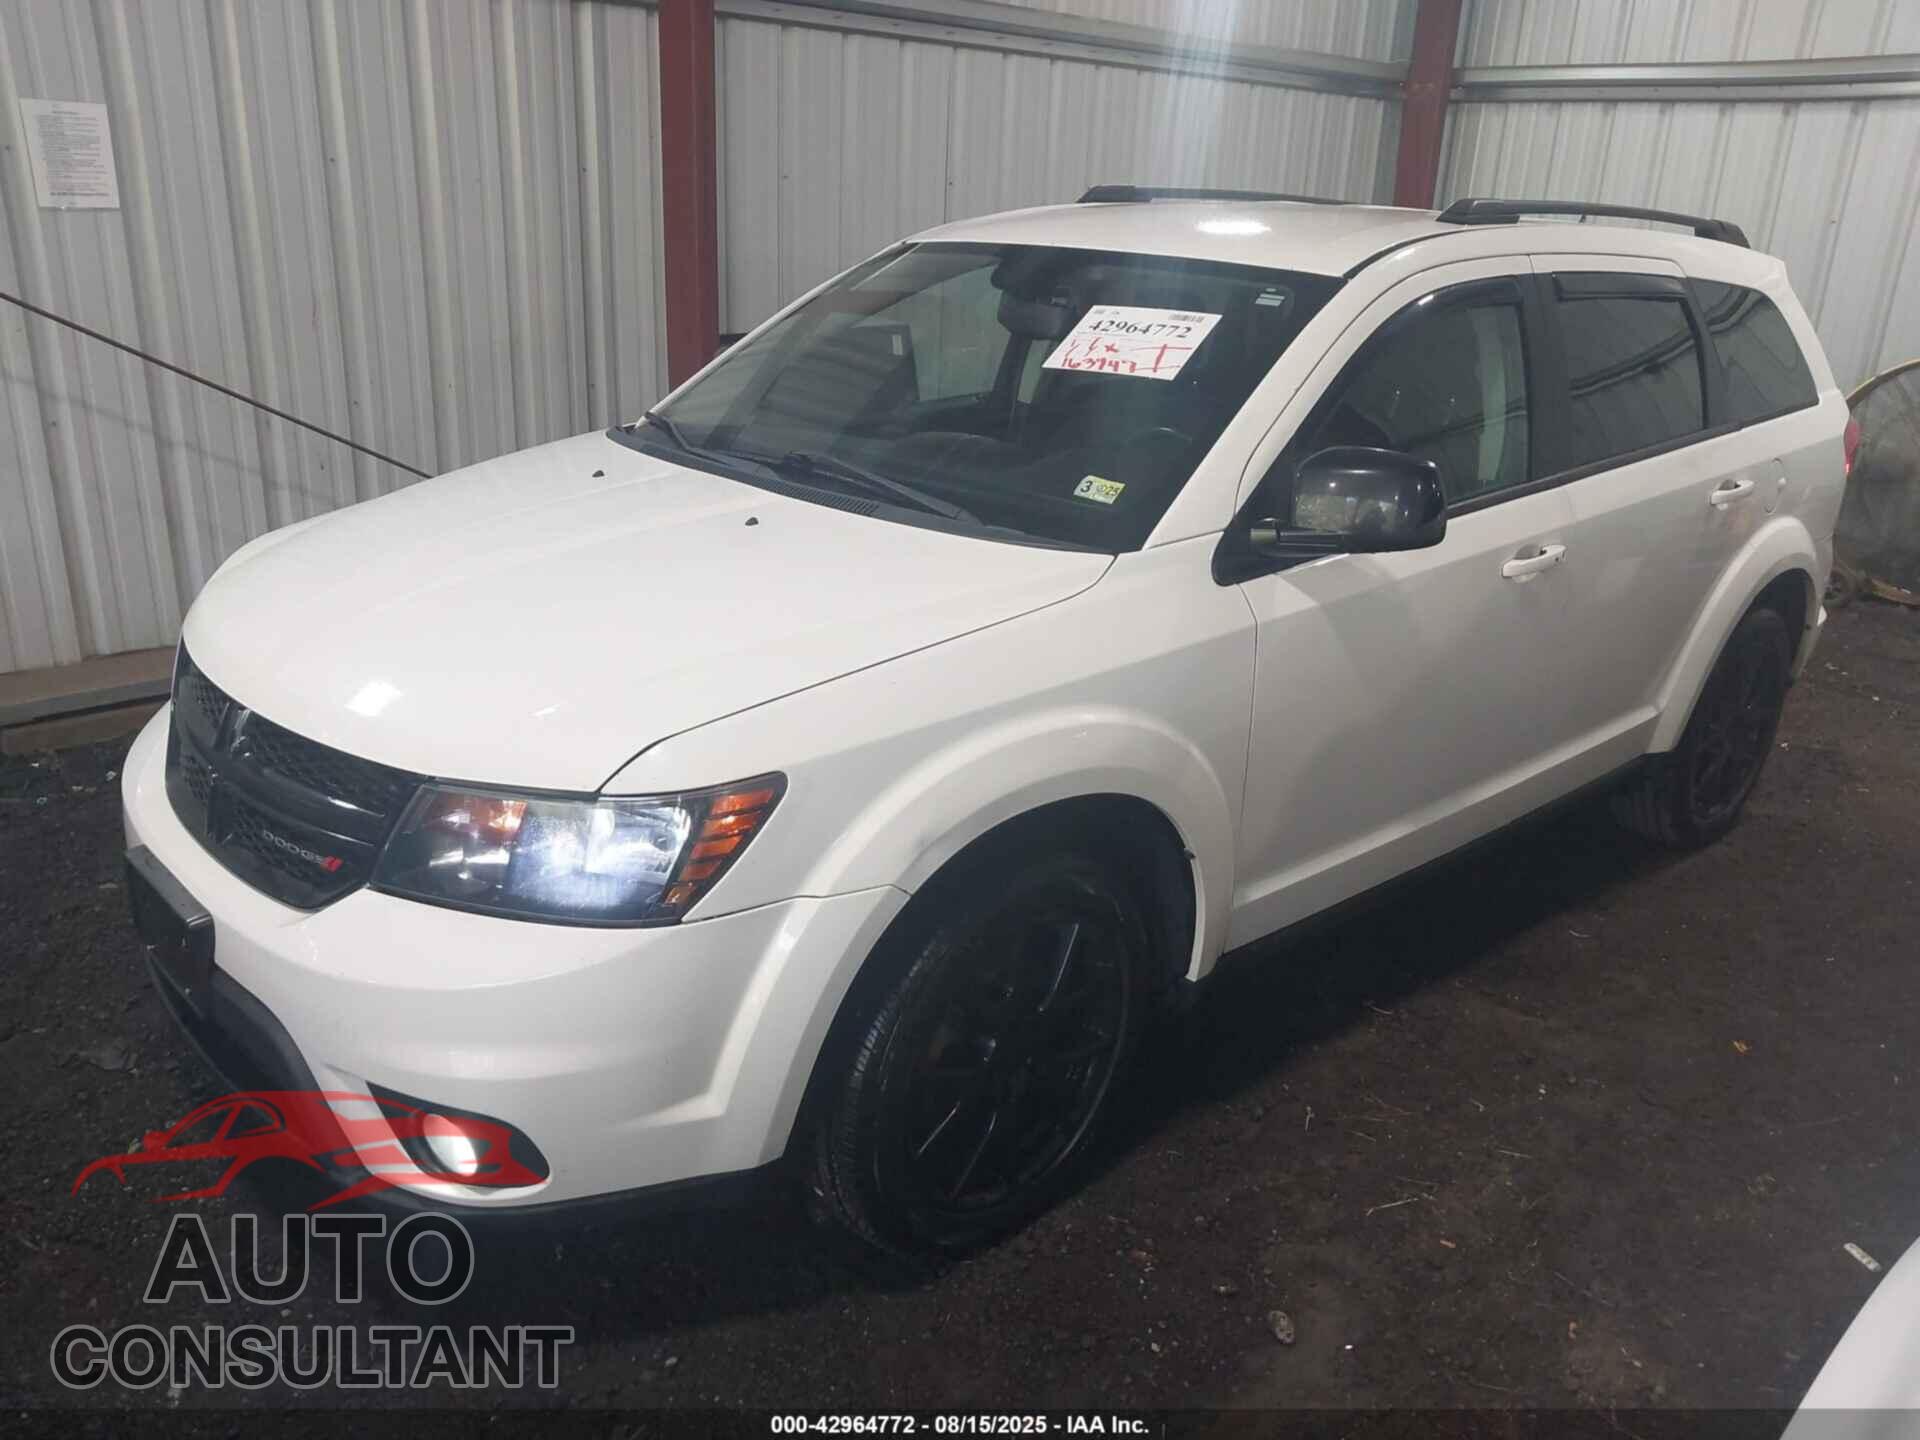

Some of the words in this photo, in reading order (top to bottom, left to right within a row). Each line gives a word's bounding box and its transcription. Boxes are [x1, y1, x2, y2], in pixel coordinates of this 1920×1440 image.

[1089, 319, 1192, 338] 42964772
[1080, 480, 1093, 493] 3
[263, 830, 322, 864] DODGE
